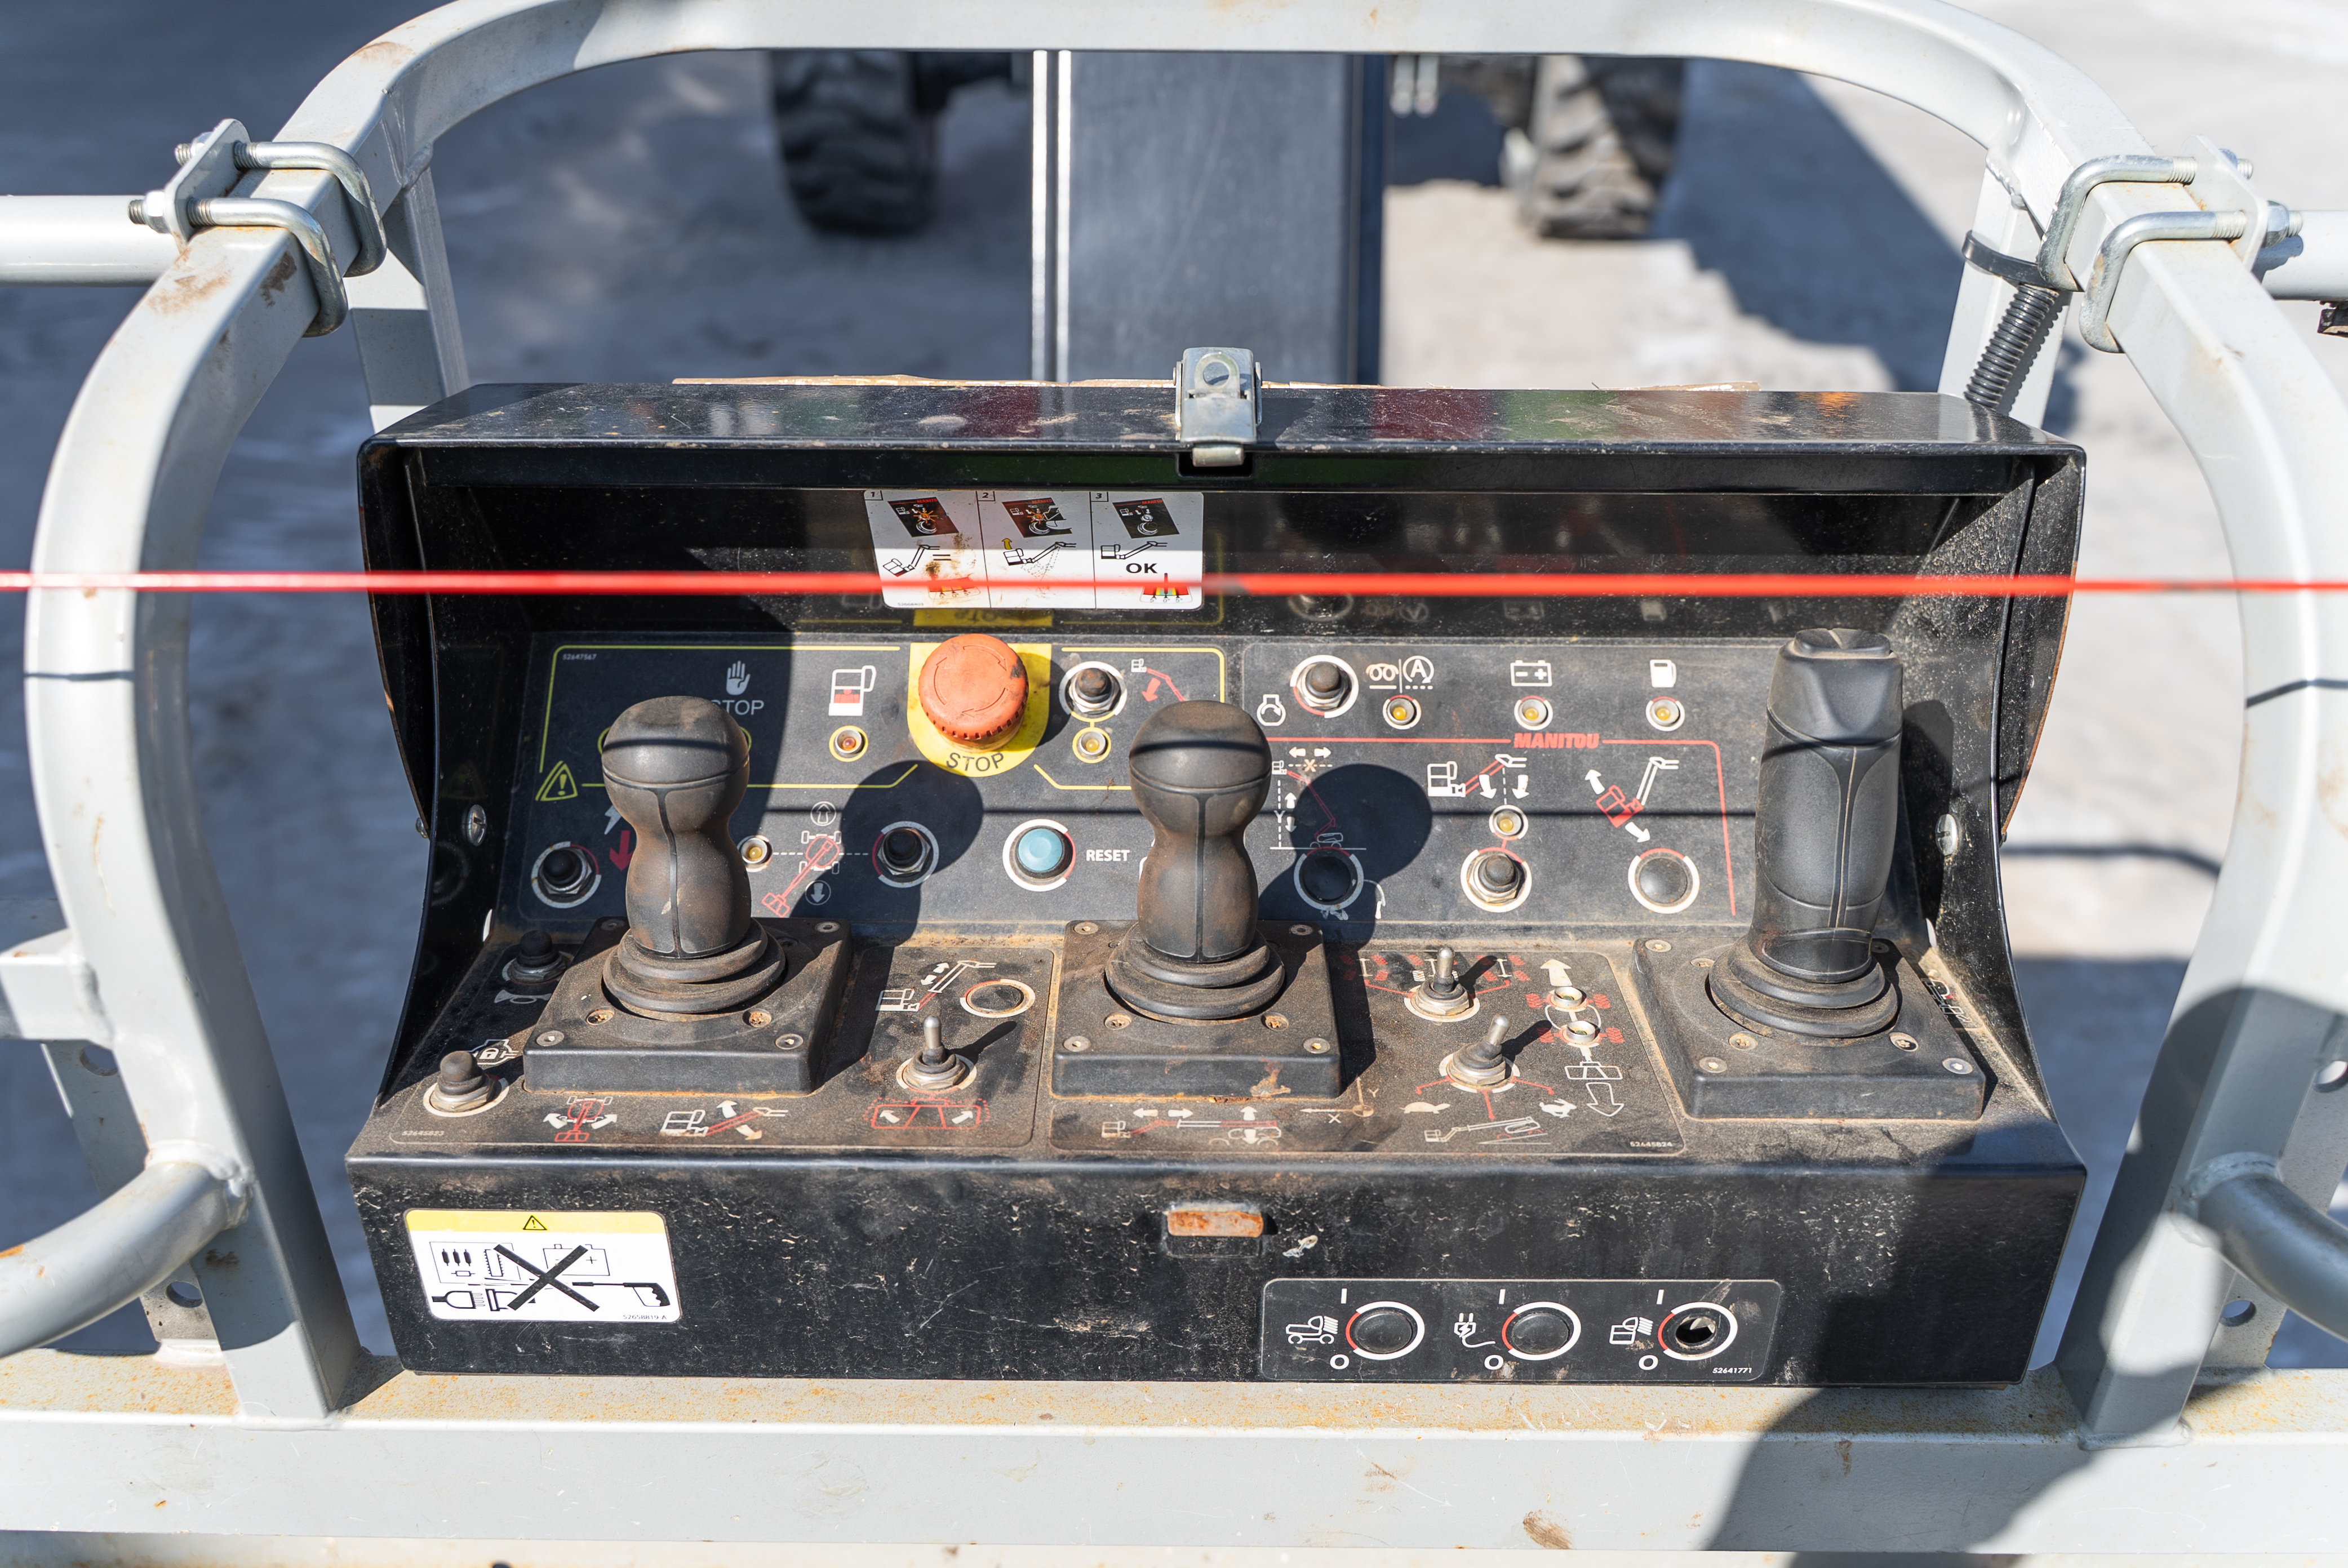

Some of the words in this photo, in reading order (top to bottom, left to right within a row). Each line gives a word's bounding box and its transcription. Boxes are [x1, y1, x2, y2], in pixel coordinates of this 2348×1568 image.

[1125, 563, 1158, 574] OK
[1513, 732, 1600, 749] MANITOU
[946, 752, 1004, 772] STOP
[1304, 759, 1316, 772] X
[1273, 810, 1285, 823] Y
[1086, 849, 1130, 861] RESET
[1367, 1088, 1379, 1098] Y
[1328, 1113, 1342, 1123] X
